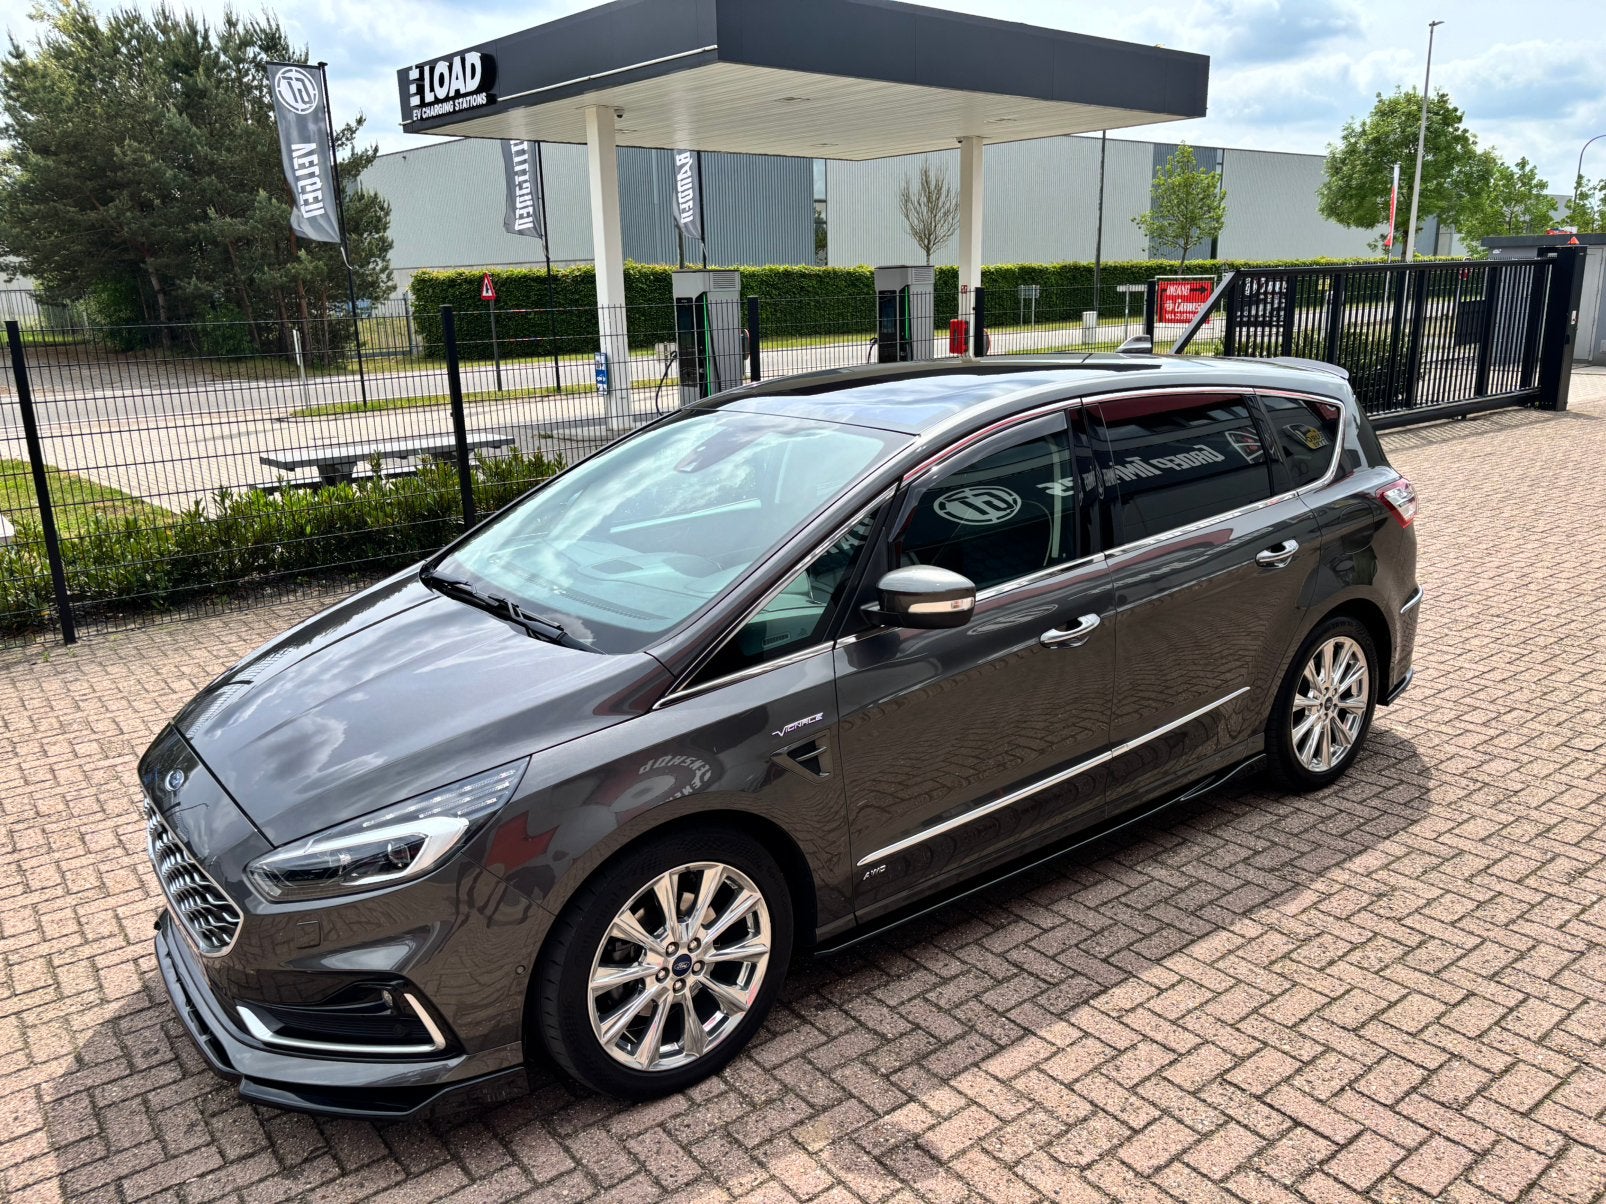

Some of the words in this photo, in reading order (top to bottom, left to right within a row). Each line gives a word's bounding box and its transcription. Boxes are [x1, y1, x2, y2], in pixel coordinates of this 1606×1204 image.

[413, 109, 421, 120] EV
[422, 100, 453, 118] CHARGING
[455, 92, 487, 111] STATIONS
